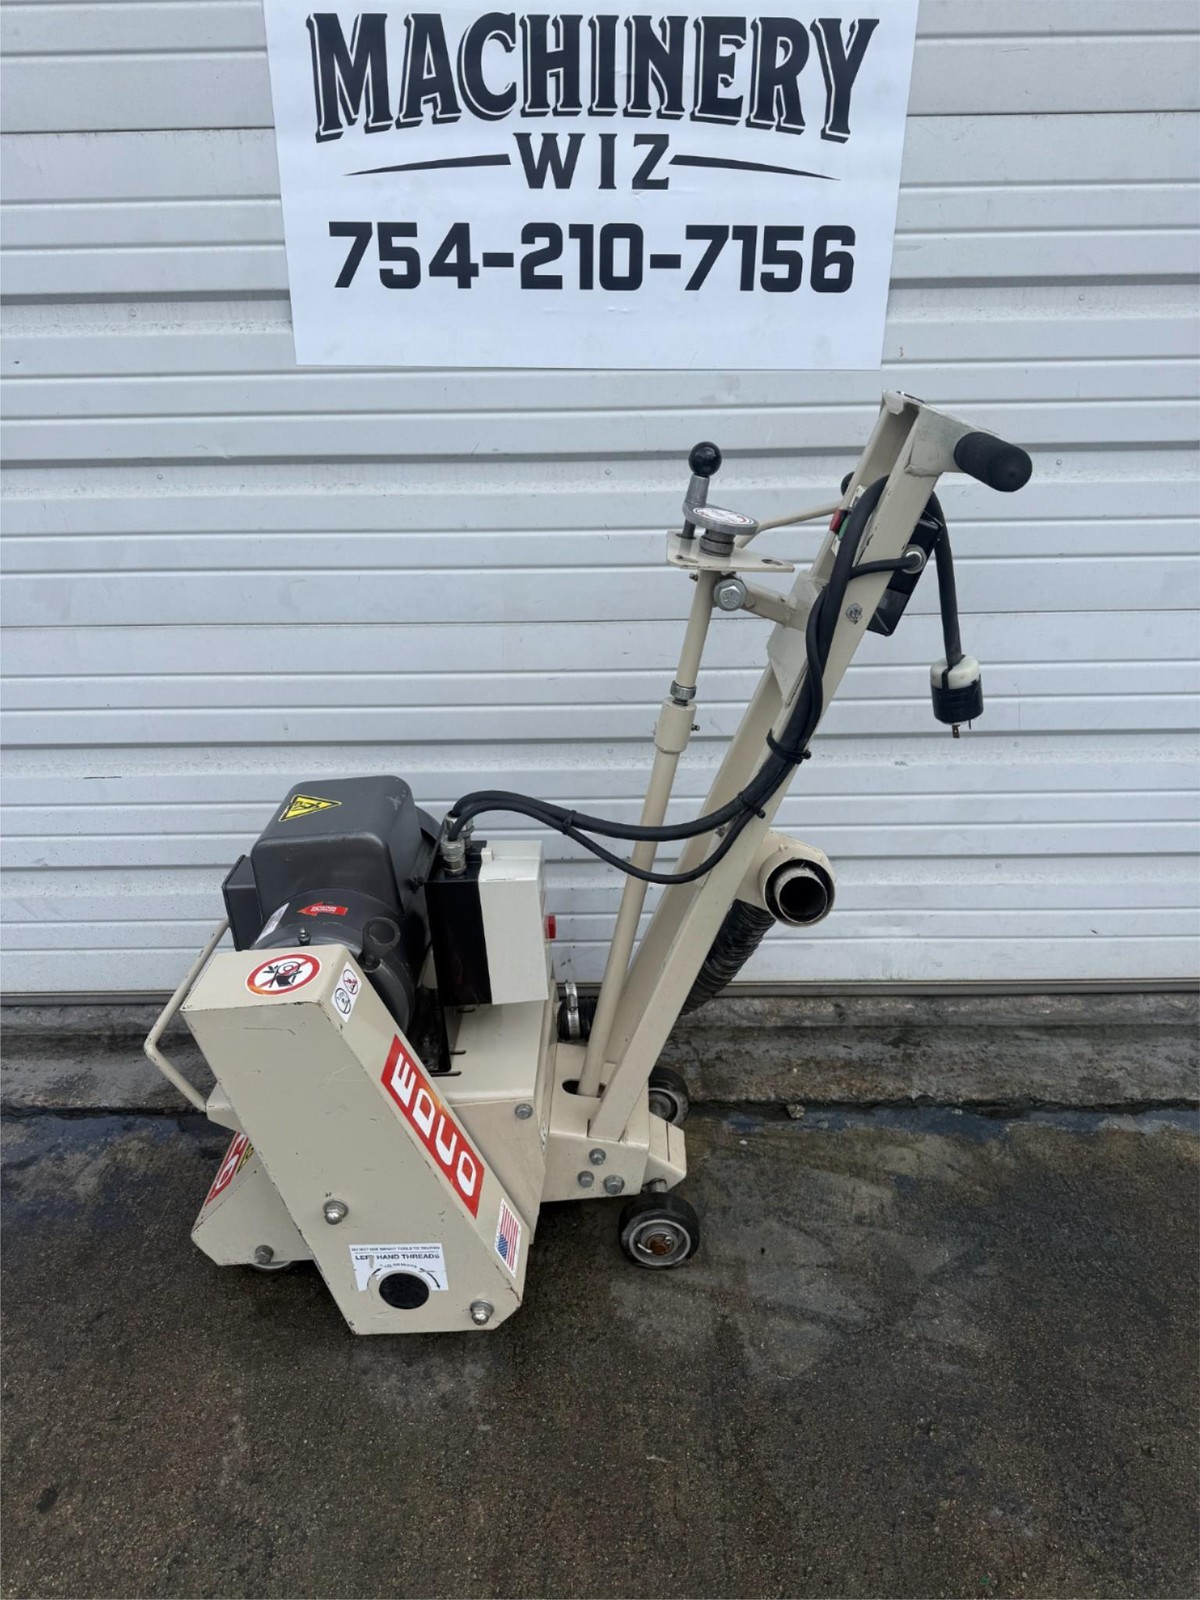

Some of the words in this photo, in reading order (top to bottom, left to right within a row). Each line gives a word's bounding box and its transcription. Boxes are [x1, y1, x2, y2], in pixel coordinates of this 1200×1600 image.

[306, 12, 880, 143] MACHINERY
[513, 132, 671, 190] WIZ
[329, 221, 856, 294] 754-210-7156
[390, 1052, 477, 1197] EDCO
